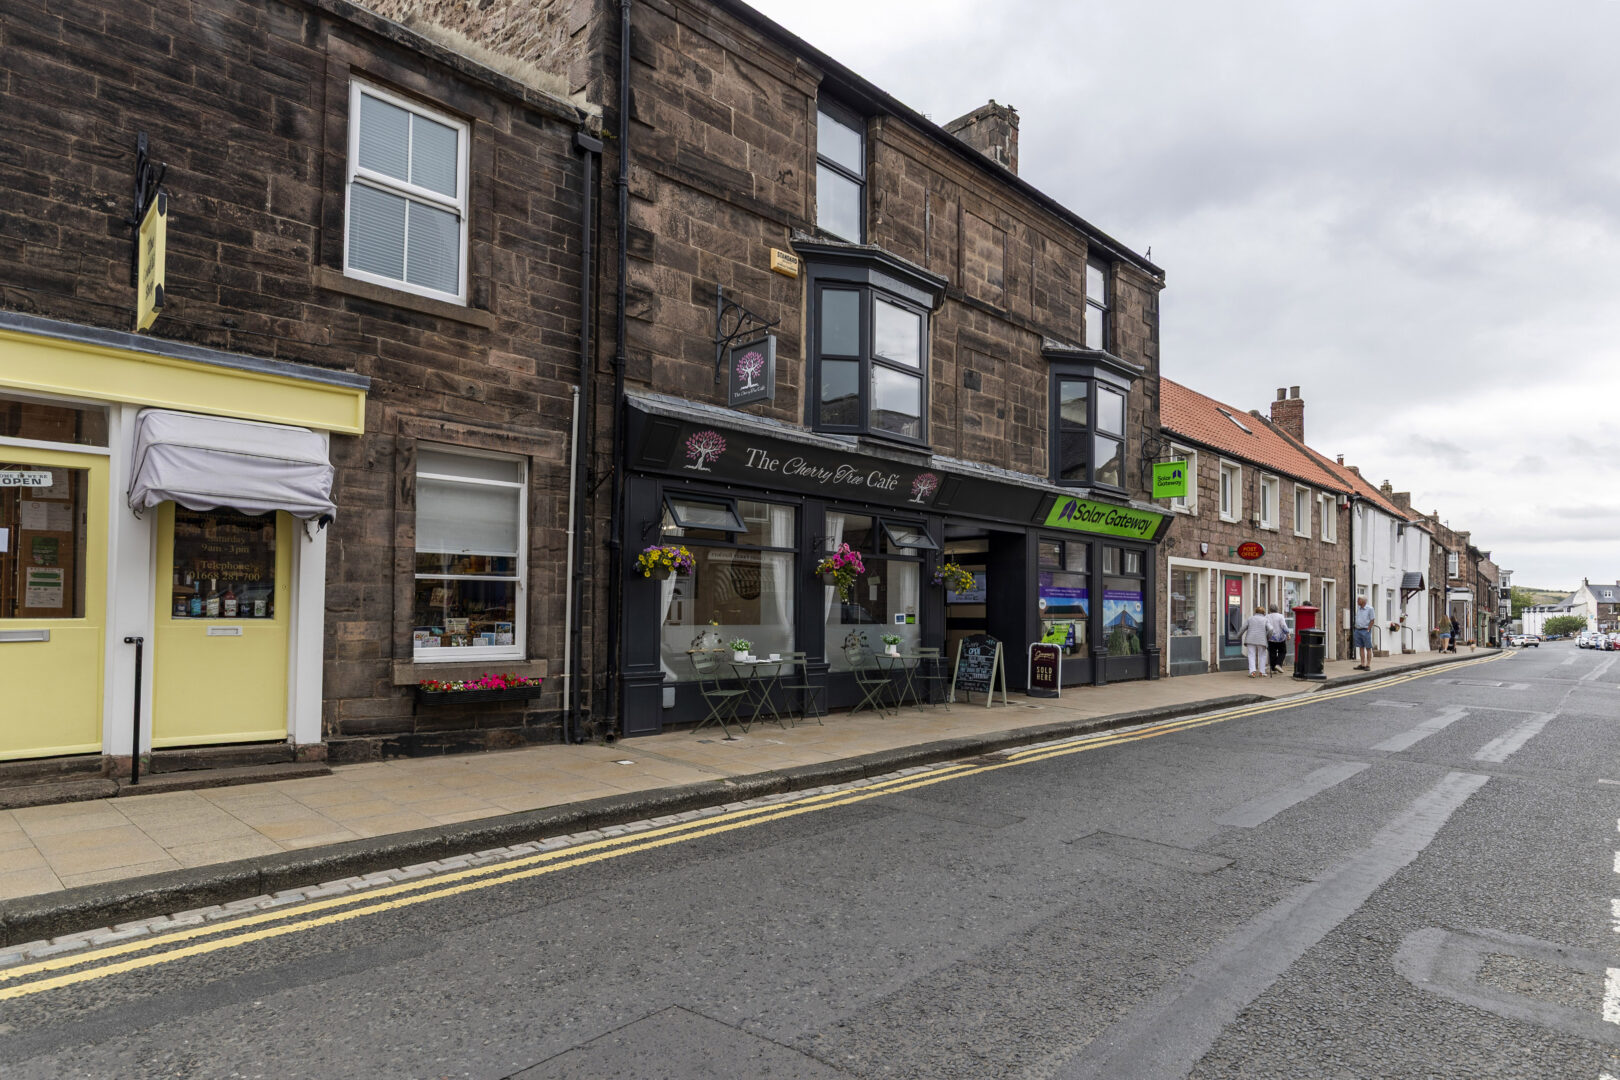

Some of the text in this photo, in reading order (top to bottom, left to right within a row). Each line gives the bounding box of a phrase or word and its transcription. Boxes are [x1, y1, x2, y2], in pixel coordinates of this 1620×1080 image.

[744, 447, 900, 490] The Cherry Tree Café
[1073, 503, 1152, 536] Solar Gateway
[189, 570, 219, 580] 01668
[243, 572, 260, 581] 700
[1036, 666, 1053, 674] SOLD
[1036, 673, 1053, 682] HERE
